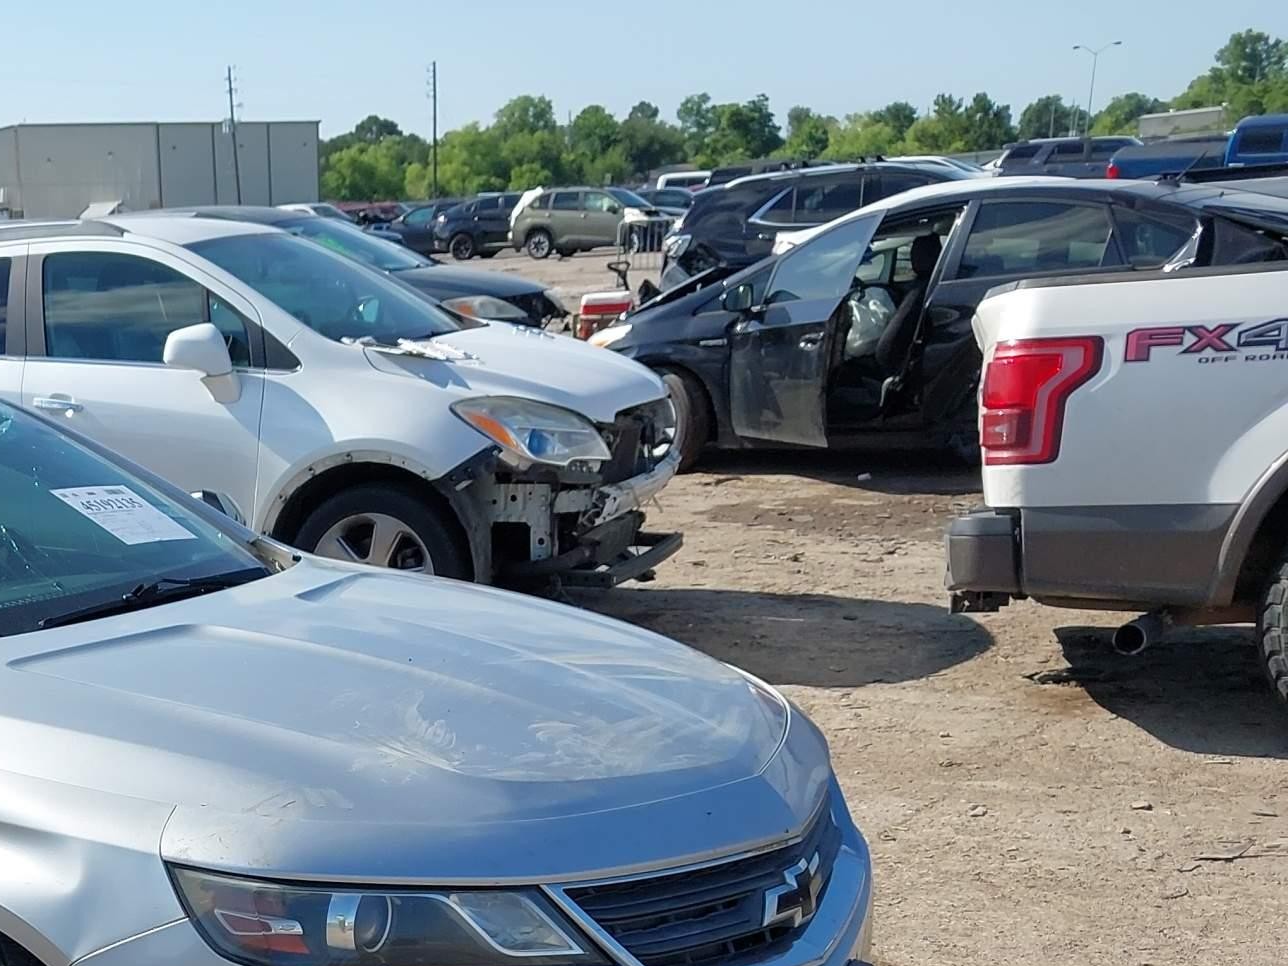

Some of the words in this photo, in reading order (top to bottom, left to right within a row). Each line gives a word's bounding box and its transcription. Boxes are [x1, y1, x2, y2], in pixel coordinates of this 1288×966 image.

[1124, 318, 1288, 363] FX4
[1197, 355, 1237, 364] OFF
[1244, 353, 1288, 362] ROA
